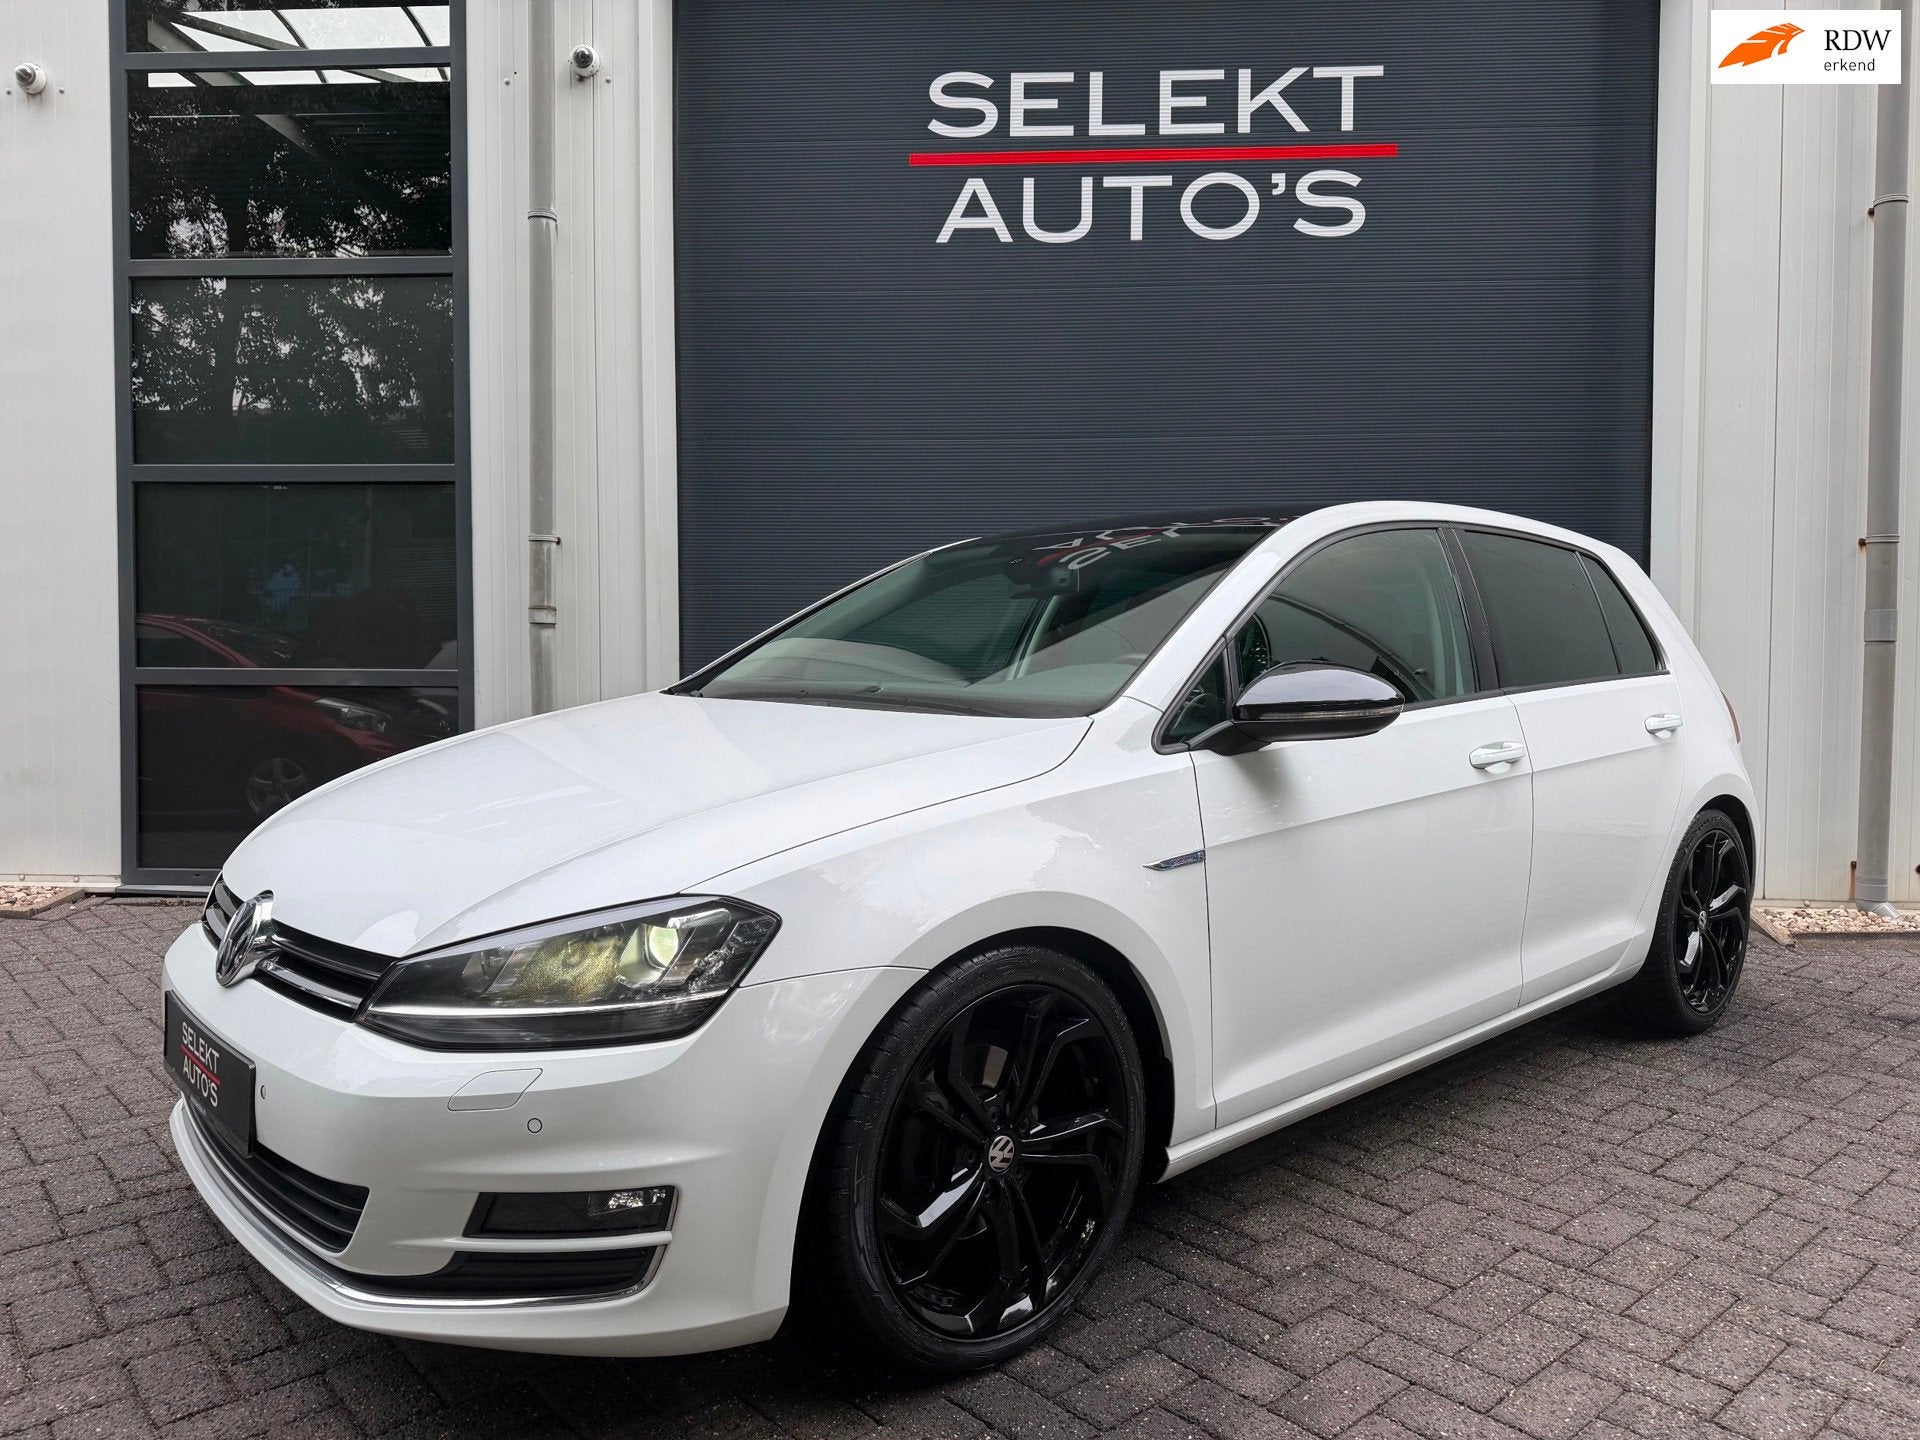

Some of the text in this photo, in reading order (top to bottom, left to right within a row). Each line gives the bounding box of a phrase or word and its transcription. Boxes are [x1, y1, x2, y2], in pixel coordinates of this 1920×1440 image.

[927, 64, 1385, 138] SELEKT
[935, 169, 1366, 244] AUTO'S
[182, 1021, 220, 1074] SELEKT
[182, 1054, 219, 1108] AUTO'S
